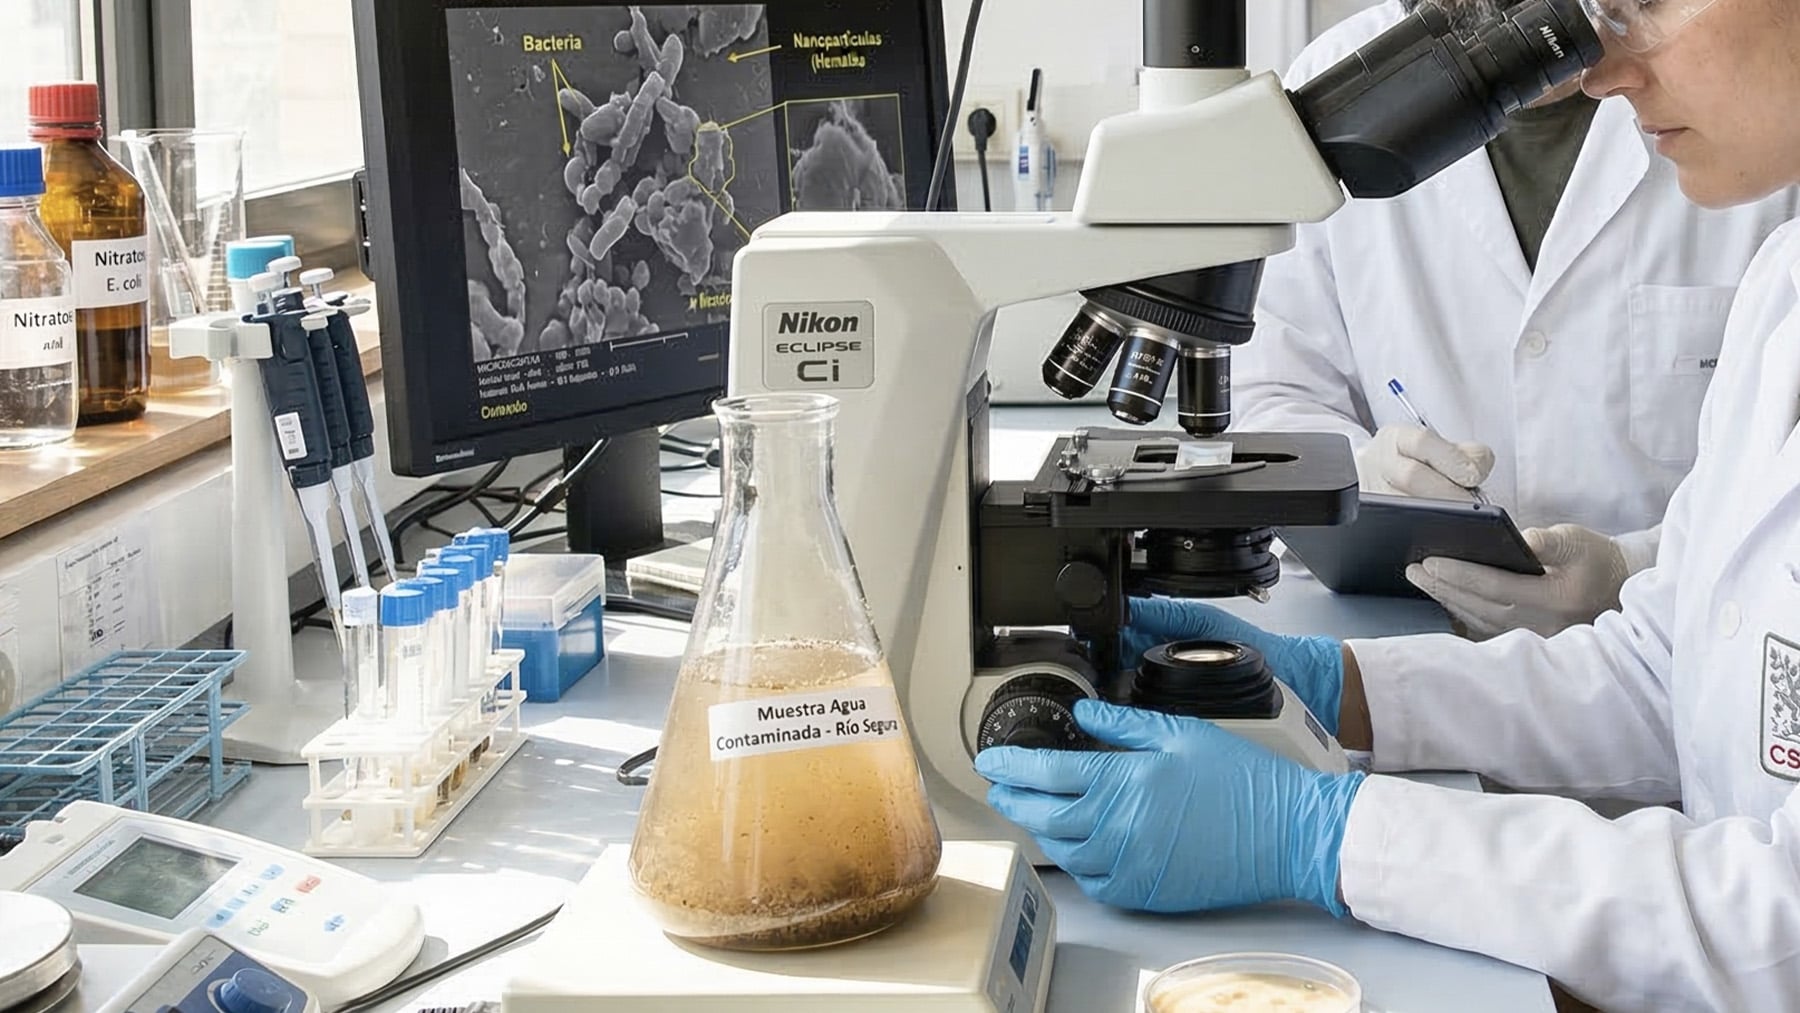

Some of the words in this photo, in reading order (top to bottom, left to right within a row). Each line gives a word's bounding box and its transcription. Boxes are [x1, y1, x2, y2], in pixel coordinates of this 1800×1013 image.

[523, 33, 582, 52] Bacteria
[107, 277, 120, 292] E.
[123, 273, 142, 291] coli
[778, 311, 859, 334] Nikon
[776, 341, 862, 353] ECLIPSE
[797, 359, 840, 382] Ci
[757, 702, 826, 722] Muestra
[830, 699, 866, 716] Agua
[716, 724, 822, 751] Contaminada
